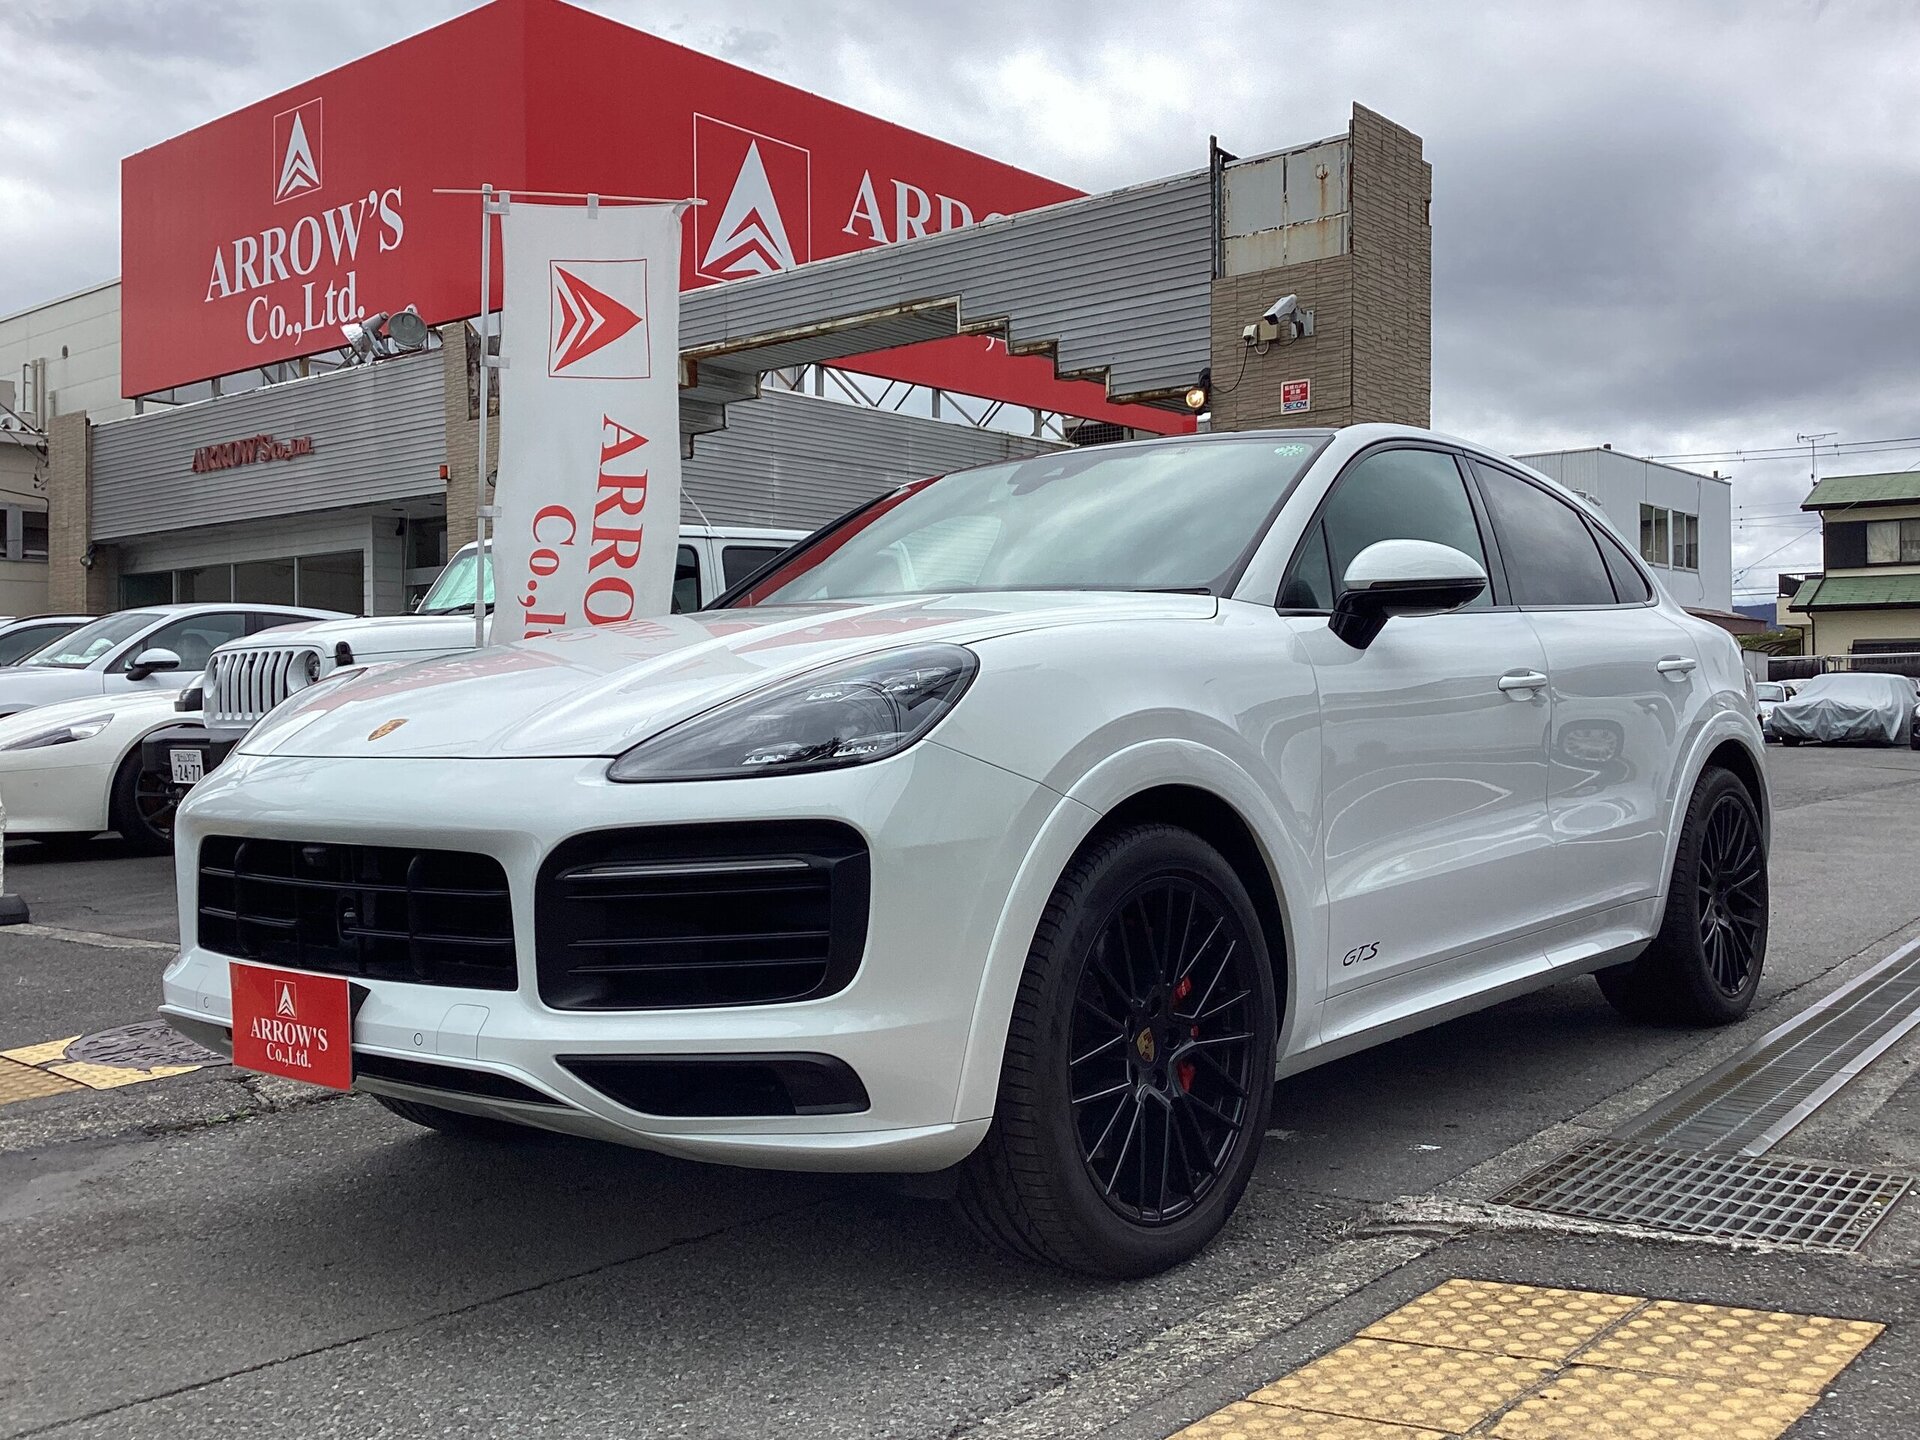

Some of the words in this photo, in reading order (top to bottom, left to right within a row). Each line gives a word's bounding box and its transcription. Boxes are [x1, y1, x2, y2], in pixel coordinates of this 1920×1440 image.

[204, 186, 404, 303] ARROW'S
[246, 271, 365, 346] Co.,Ltd.
[1342, 941, 1381, 967] GTS
[251, 1016, 328, 1052] ARROW'S
[266, 1042, 312, 1068] Co.,Ltd.
